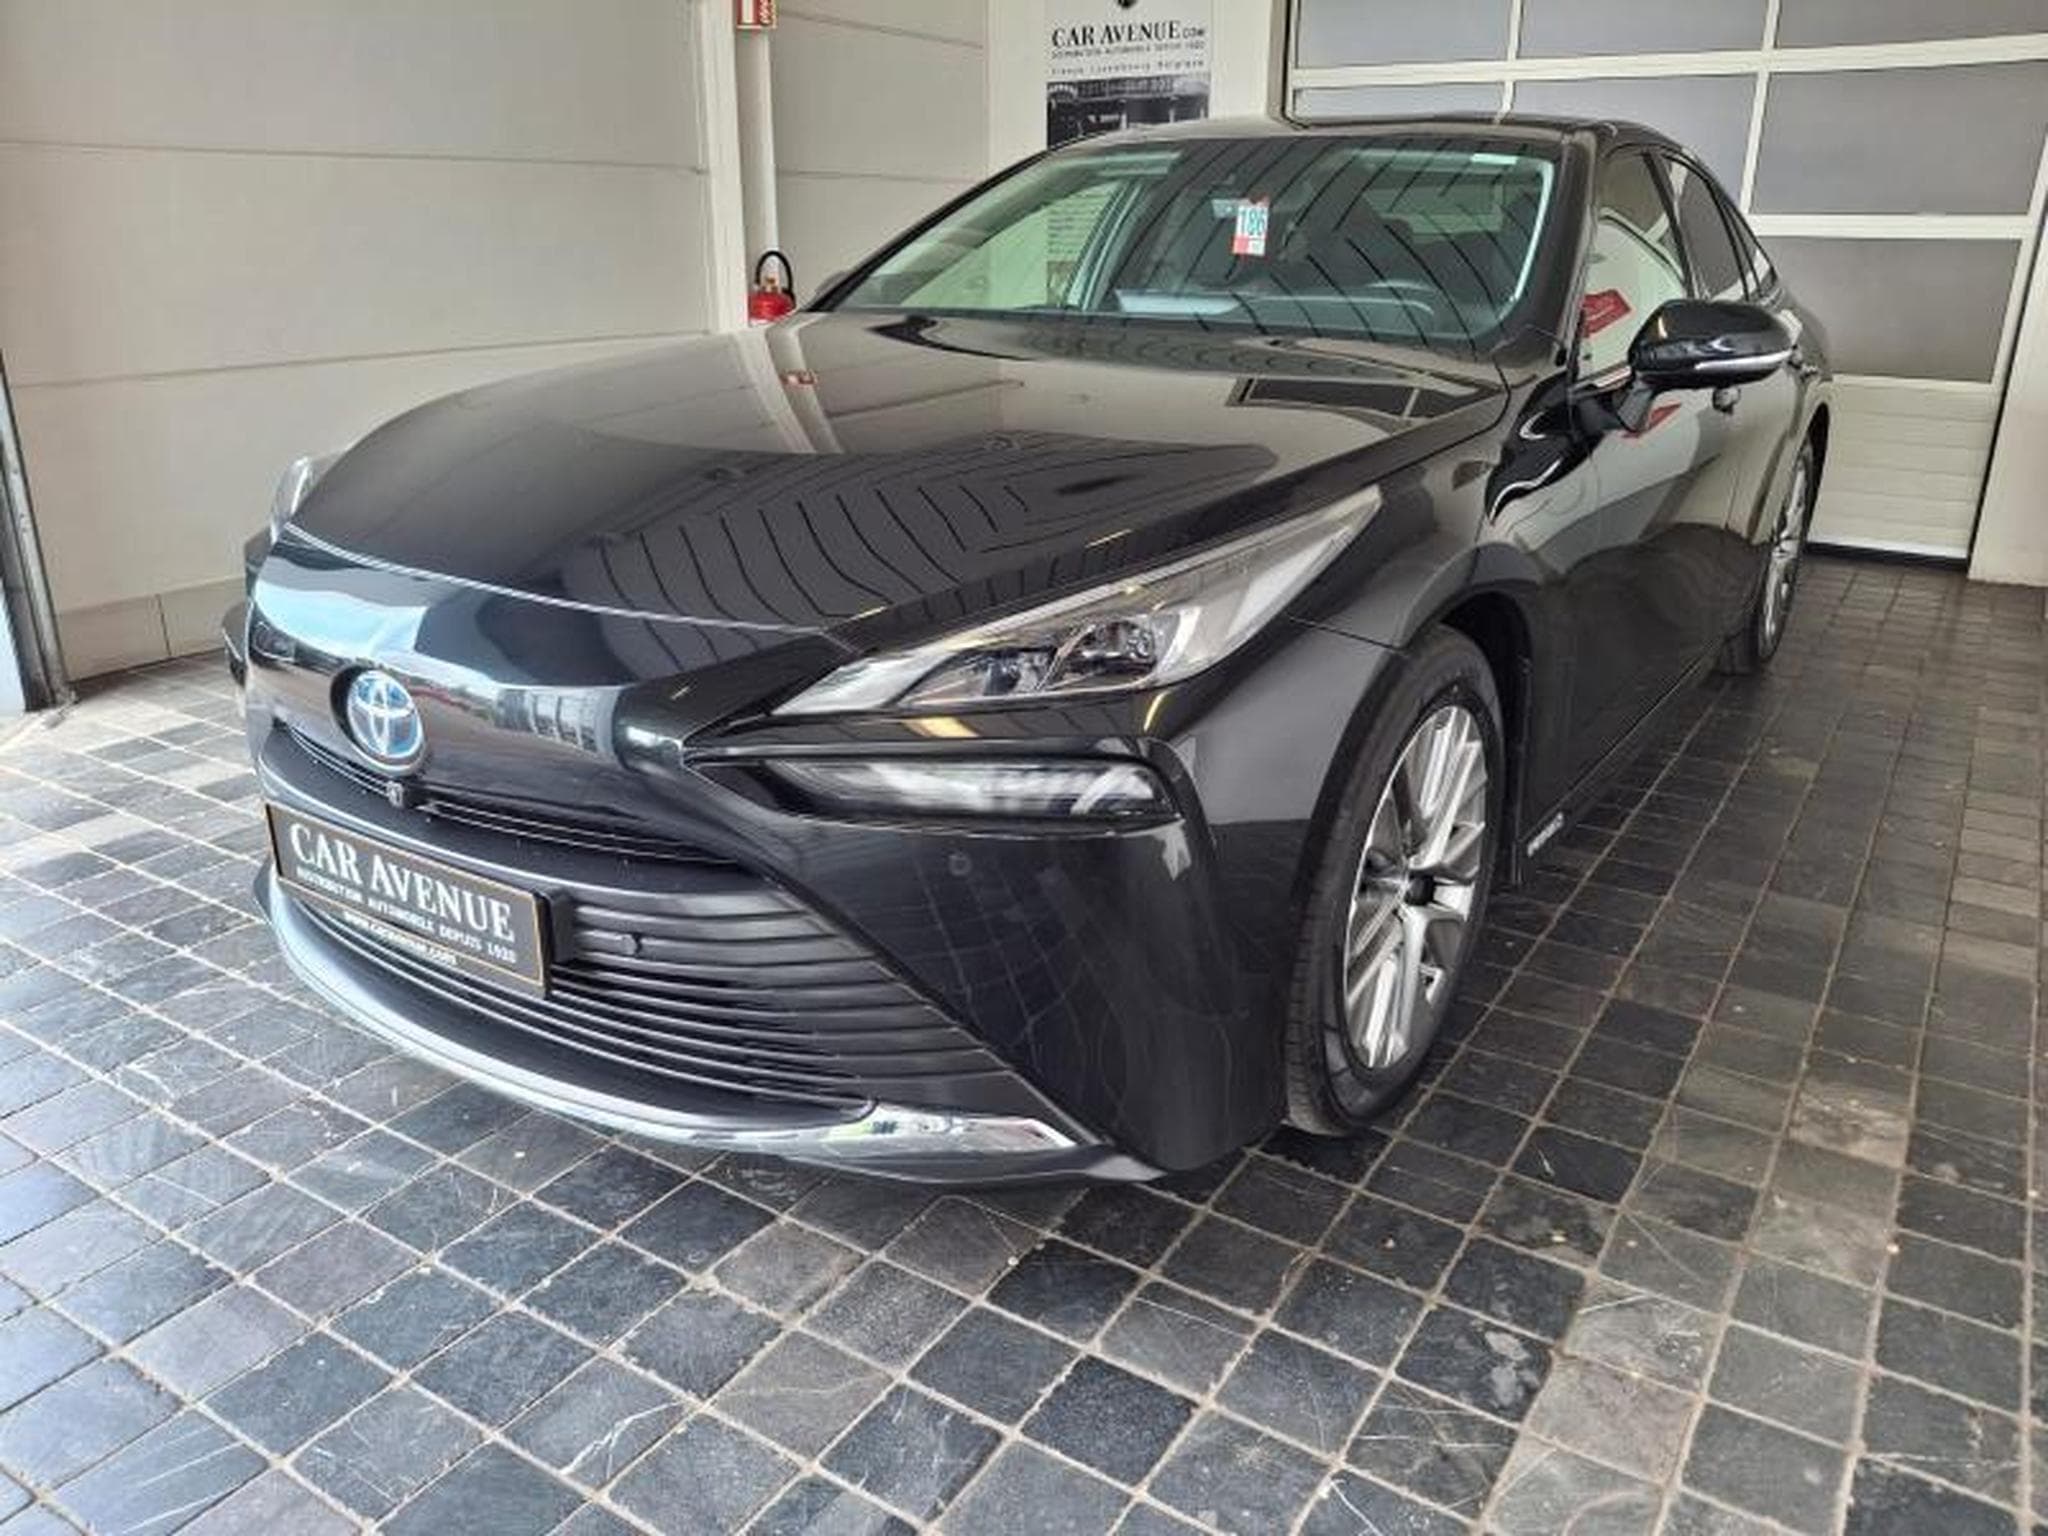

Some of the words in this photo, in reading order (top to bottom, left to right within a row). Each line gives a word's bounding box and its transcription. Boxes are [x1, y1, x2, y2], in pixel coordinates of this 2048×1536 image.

[1052, 26, 1094, 48] CAR
[1101, 20, 1181, 45] AVENUE
[290, 823, 363, 885] CAR
[370, 853, 515, 942] AVENUE
